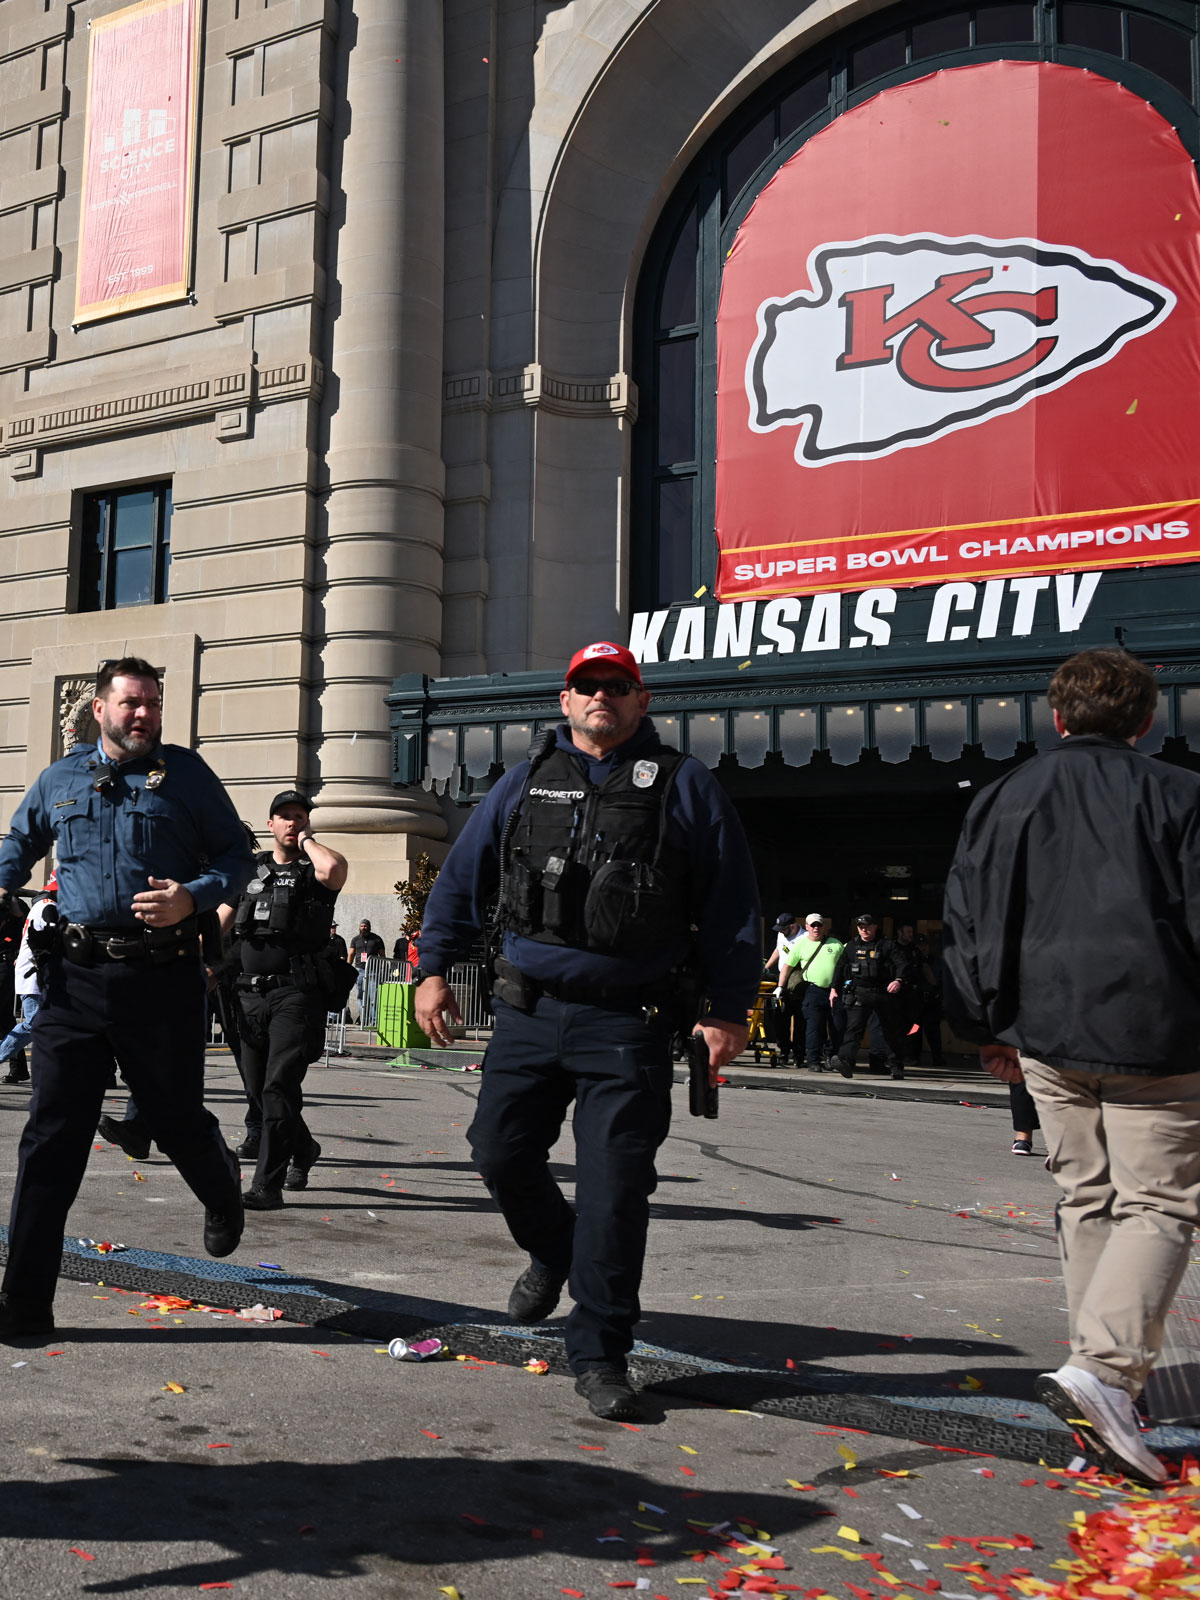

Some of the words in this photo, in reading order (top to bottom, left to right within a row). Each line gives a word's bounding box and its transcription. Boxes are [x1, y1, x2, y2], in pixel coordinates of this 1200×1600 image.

[100, 138, 176, 174] SCIENCE
[121, 160, 153, 180] CITY
[107, 271, 129, 285] EST.
[130, 264, 154, 278] 1999
[836, 266, 1059, 393] KC
[734, 556, 837, 581] SUPER
[846, 545, 949, 570] BOWL
[959, 520, 1191, 559] CHAMPIONS
[628, 588, 897, 664] KANSAS
[926, 572, 1103, 643] CITY
[529, 787, 585, 799] CAPONETTO
